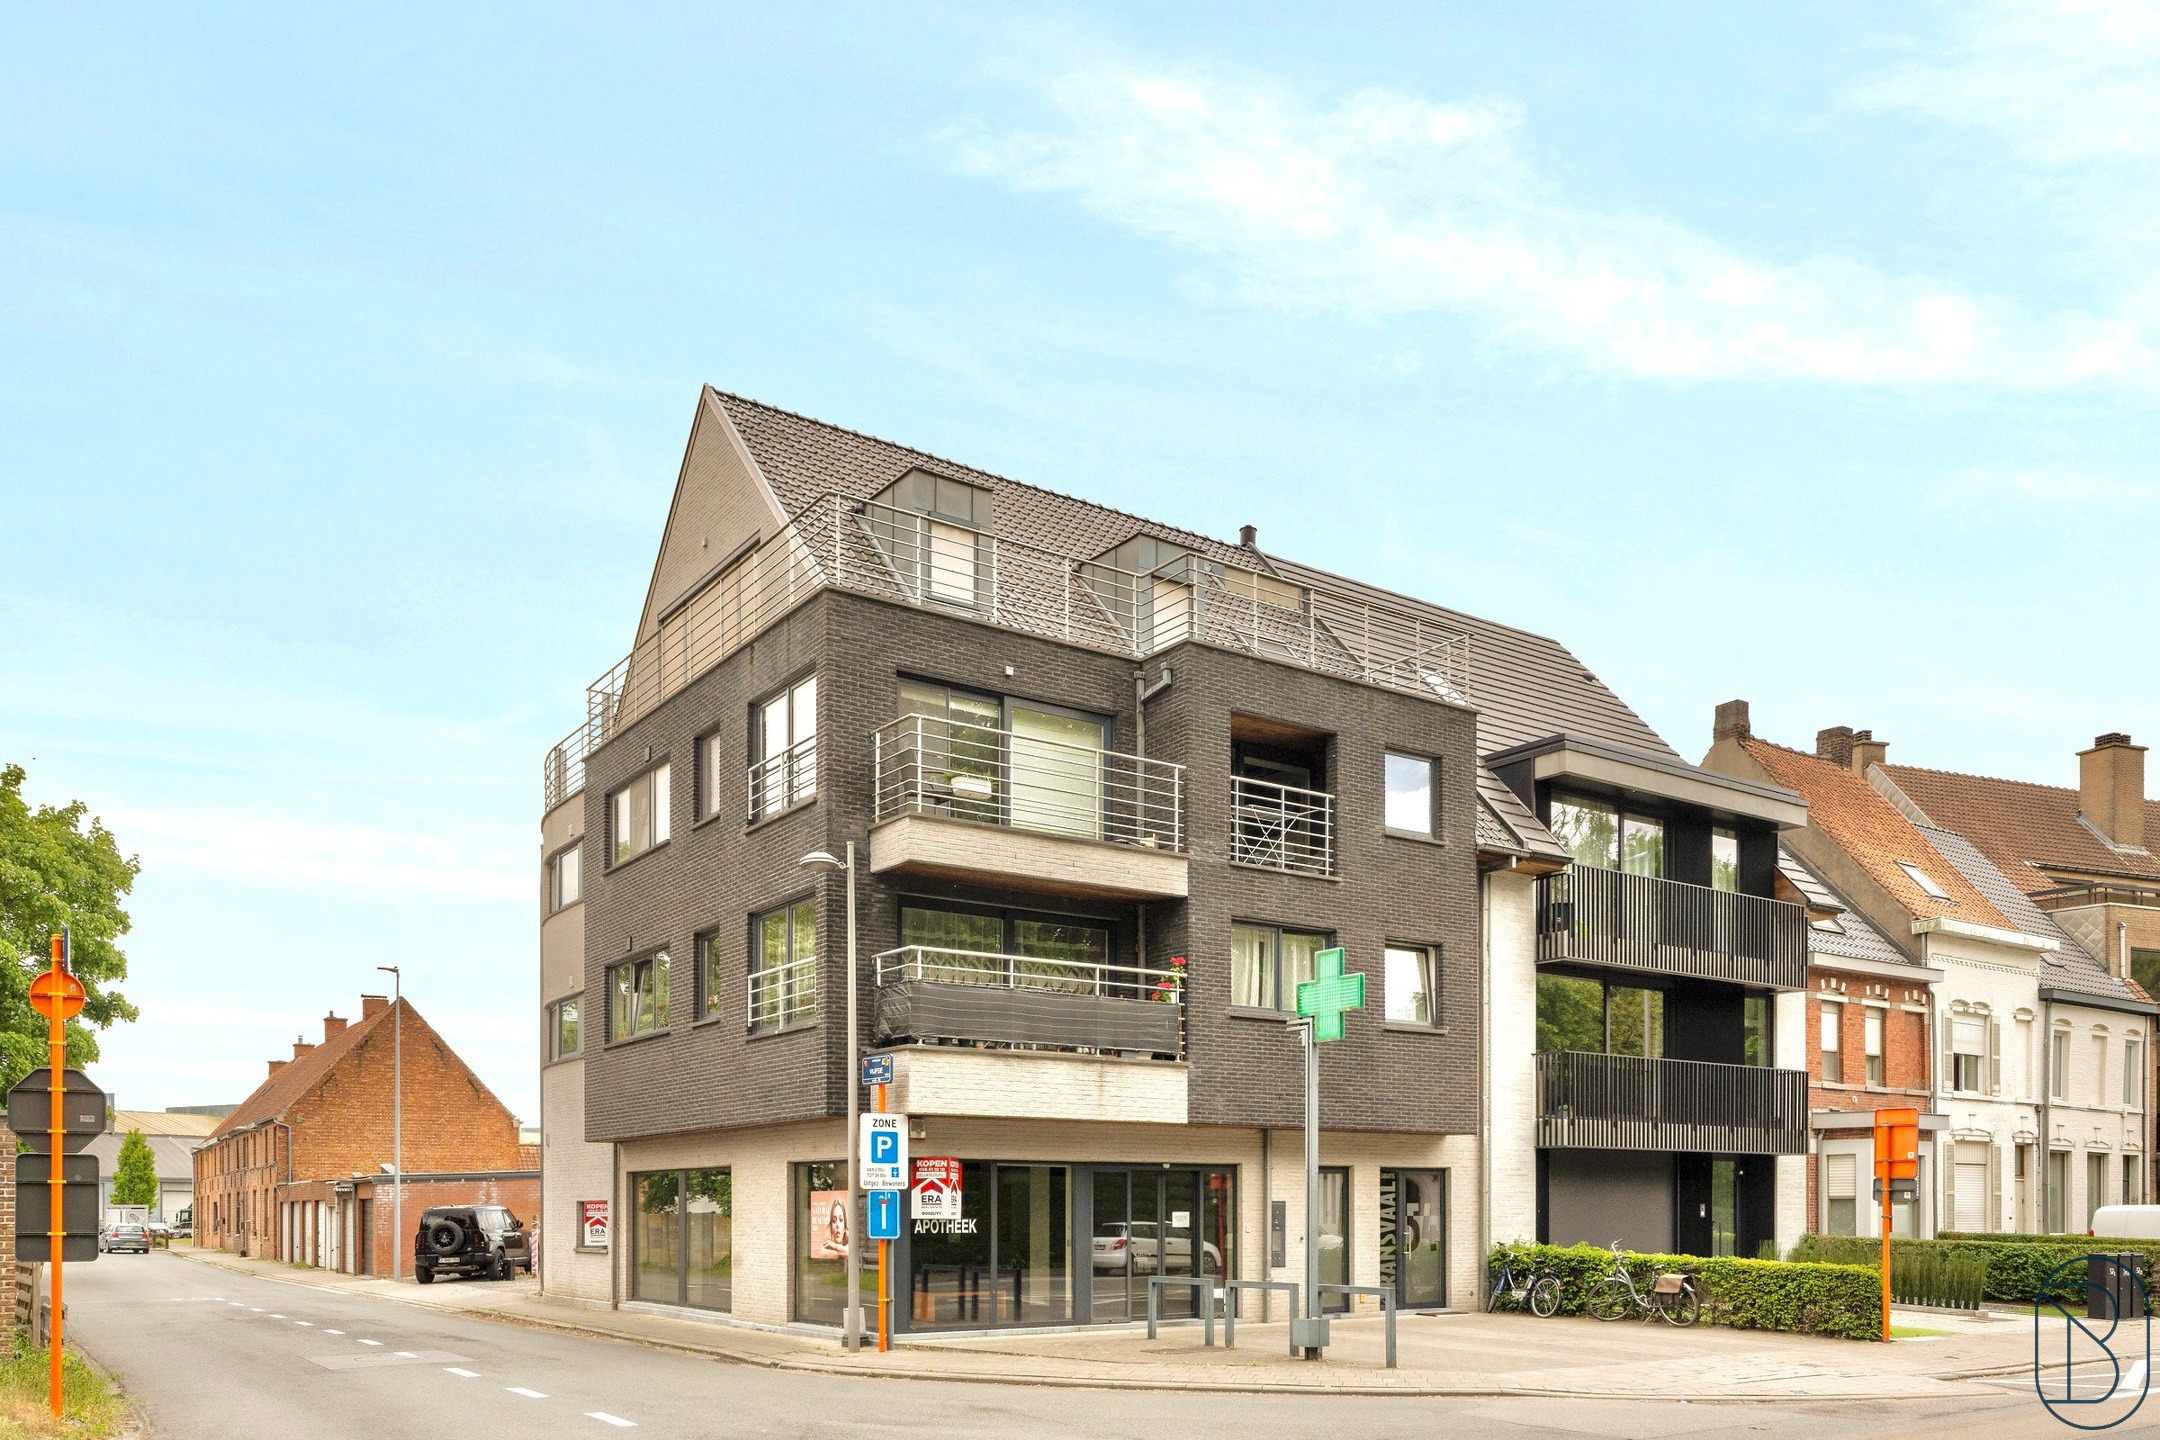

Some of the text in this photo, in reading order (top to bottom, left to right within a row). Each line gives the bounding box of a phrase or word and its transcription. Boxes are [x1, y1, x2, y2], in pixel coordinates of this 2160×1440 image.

[873, 1119, 897, 1128] ZONE
[877, 1136, 892, 1159] P
[921, 1195, 942, 1203] ERA
[914, 1219, 978, 1234] APOTHEEK
[1380, 1181, 1396, 1288] RANSVAAL
